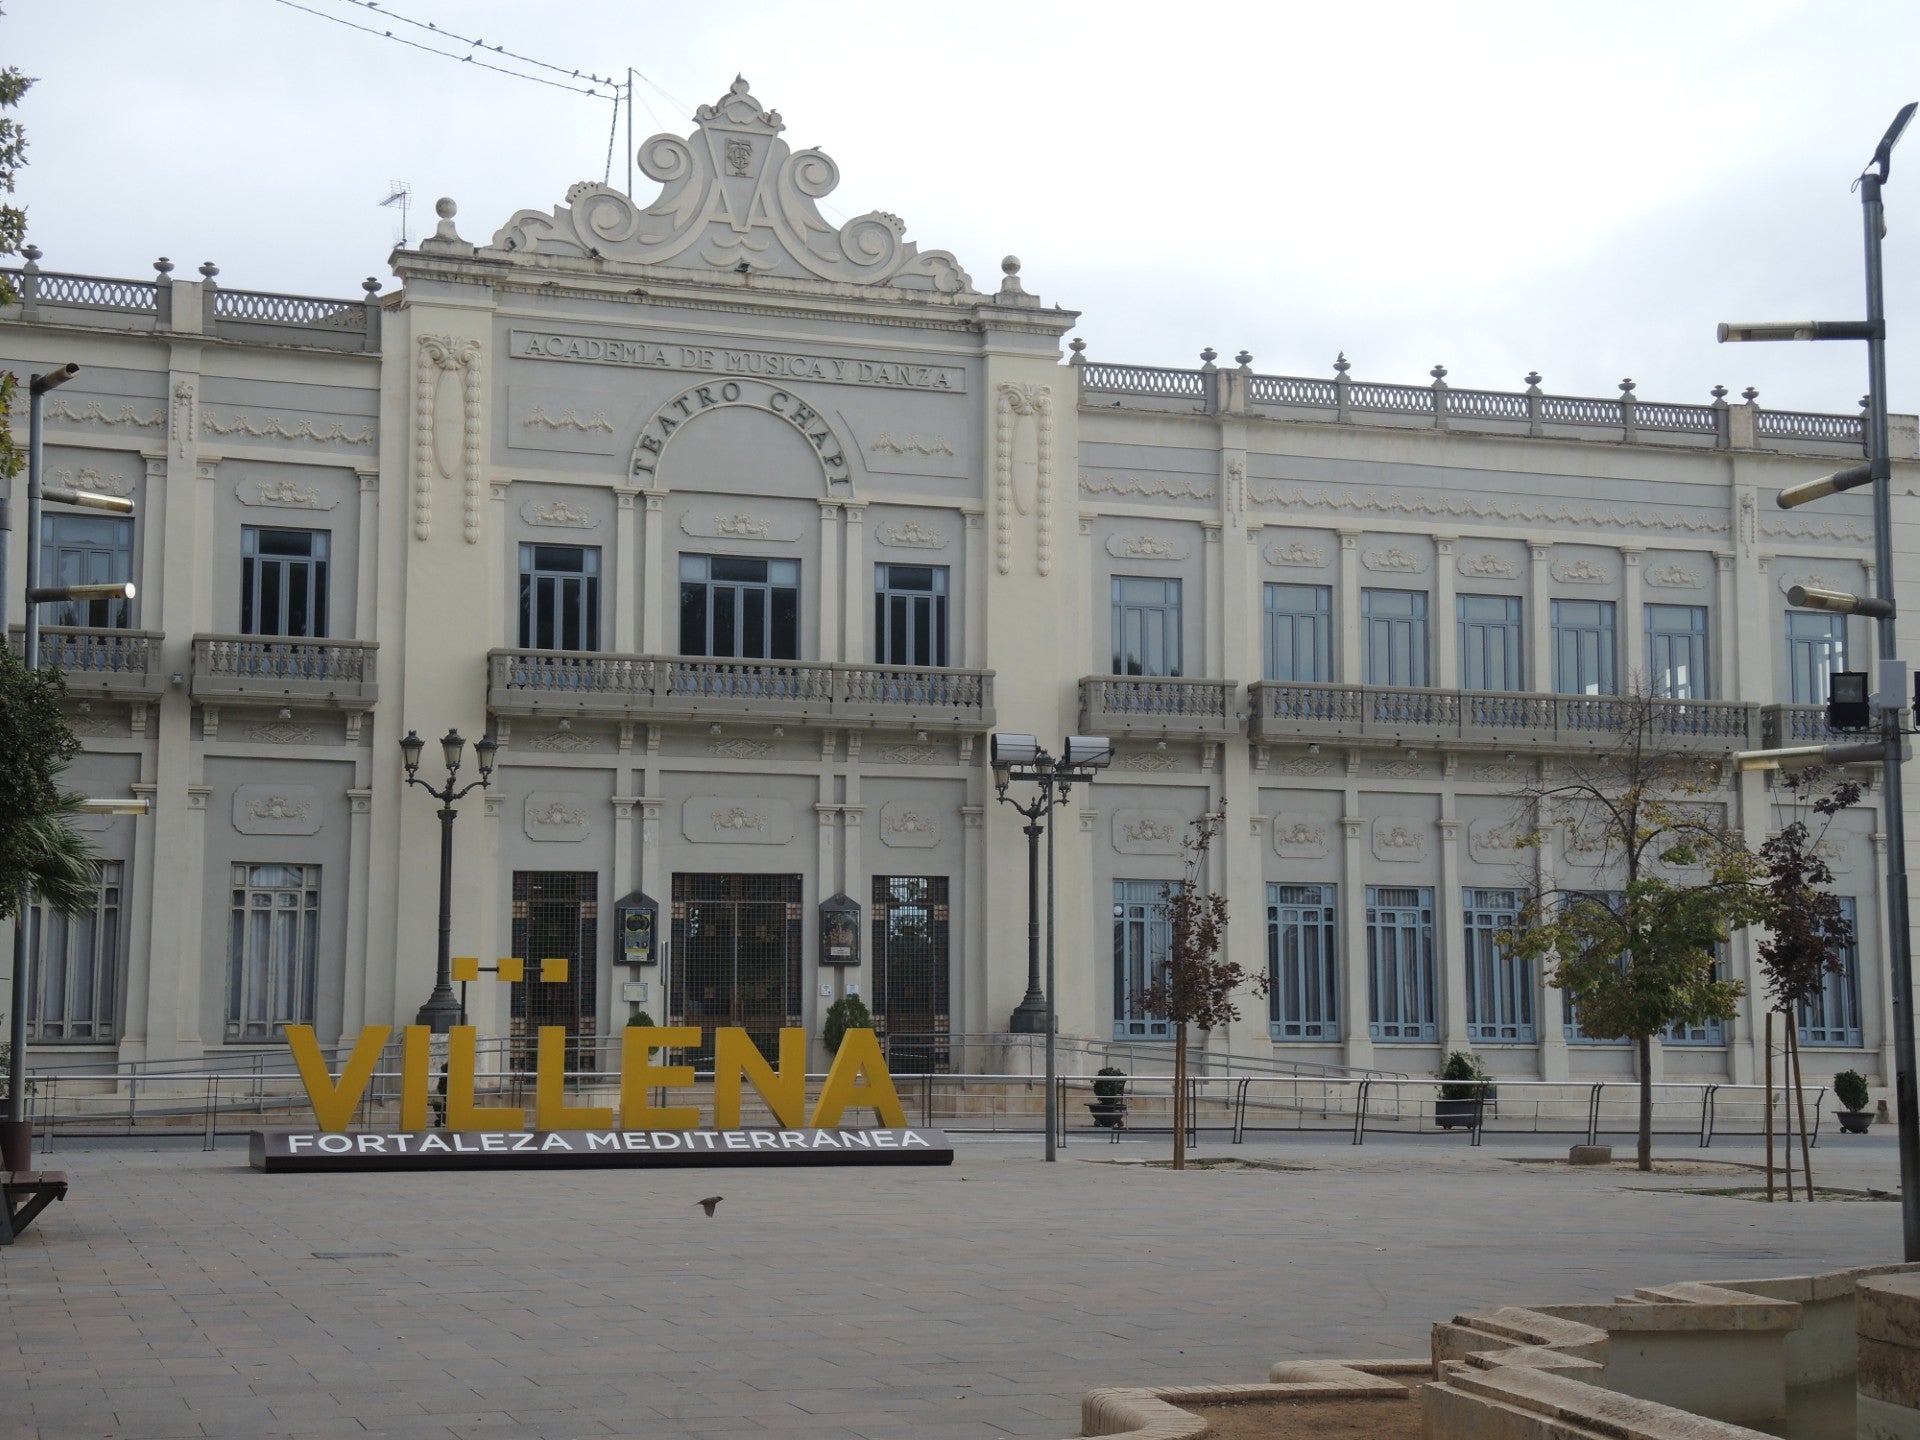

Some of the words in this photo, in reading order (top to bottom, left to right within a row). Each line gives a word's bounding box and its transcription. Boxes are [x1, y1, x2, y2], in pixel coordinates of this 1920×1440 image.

[525, 334, 670, 367] ACADEMIA
[680, 347, 715, 369] DE
[725, 351, 826, 380] MUSICA
[832, 360, 856, 380] Y
[858, 362, 952, 390] DANZA
[633, 382, 741, 476] TEATRO
[769, 392, 849, 486] CHAPI
[283, 1024, 908, 1131] VILLENA
[288, 1132, 573, 1154] FORTALEZA
[586, 1128, 930, 1151] MEDITERRÁNEA
